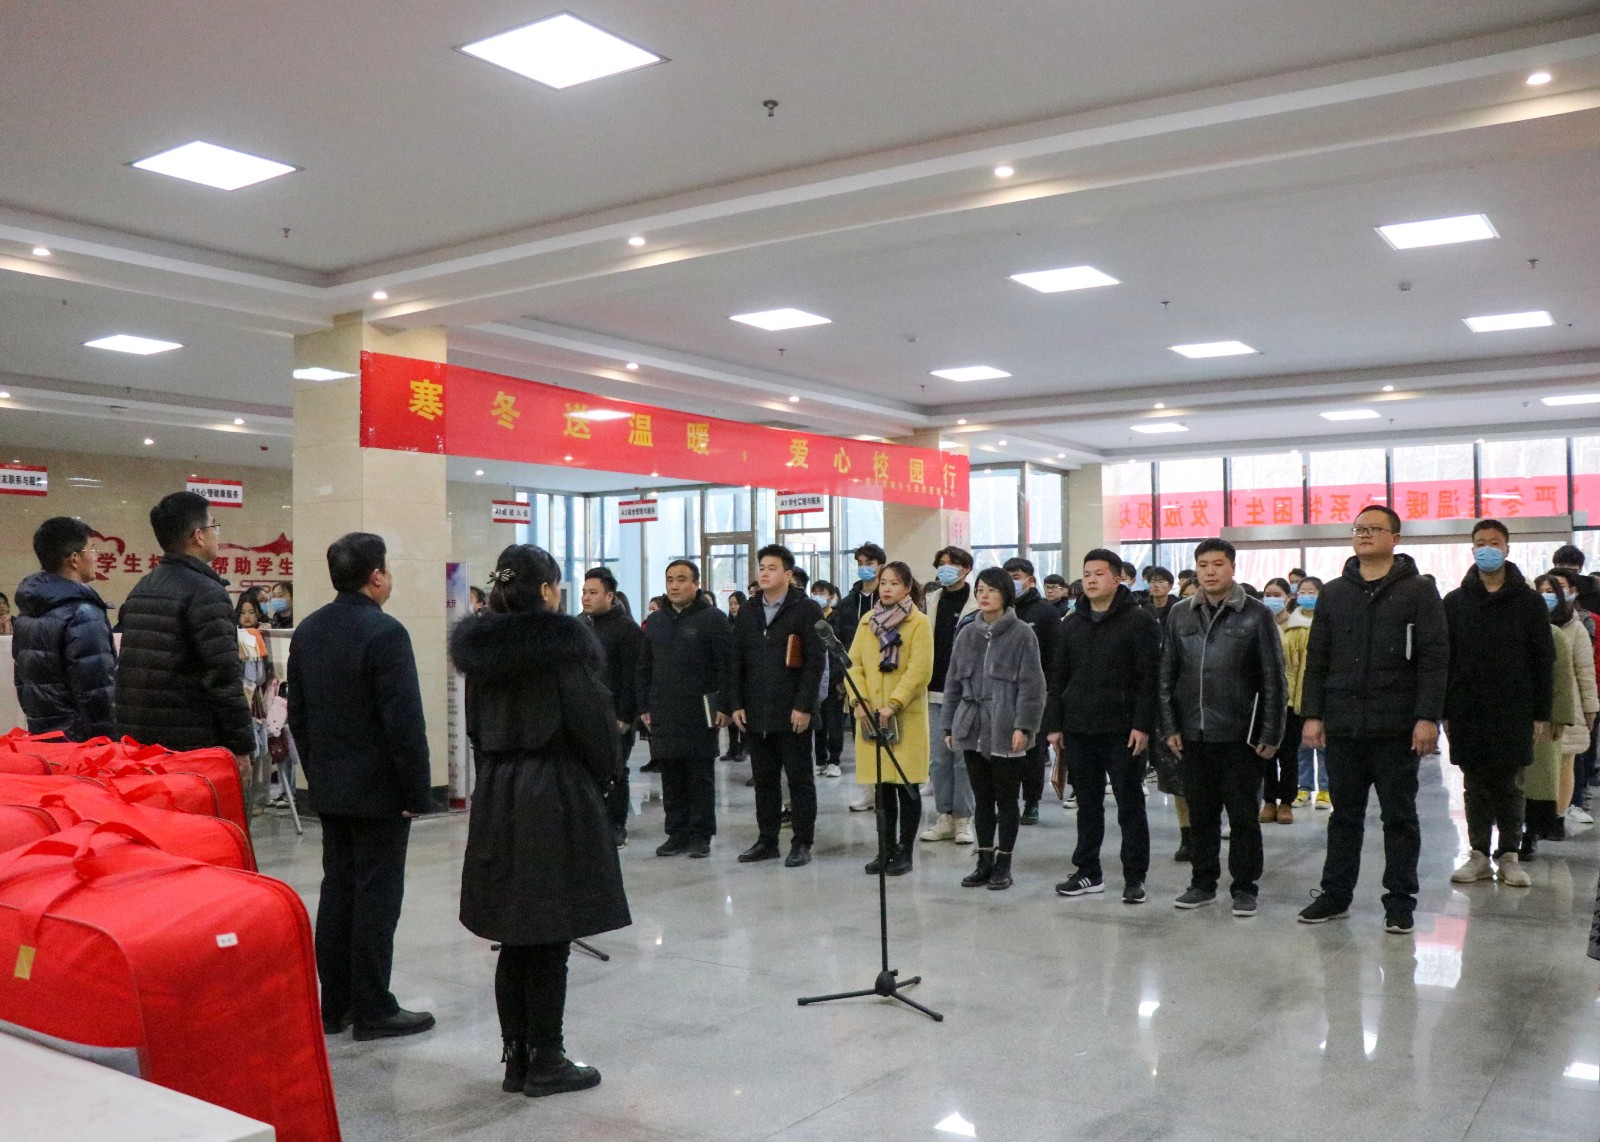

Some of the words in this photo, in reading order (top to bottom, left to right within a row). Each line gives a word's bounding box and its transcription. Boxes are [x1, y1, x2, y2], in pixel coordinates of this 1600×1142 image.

[0, 474, 42, 487] 友联系与服务
